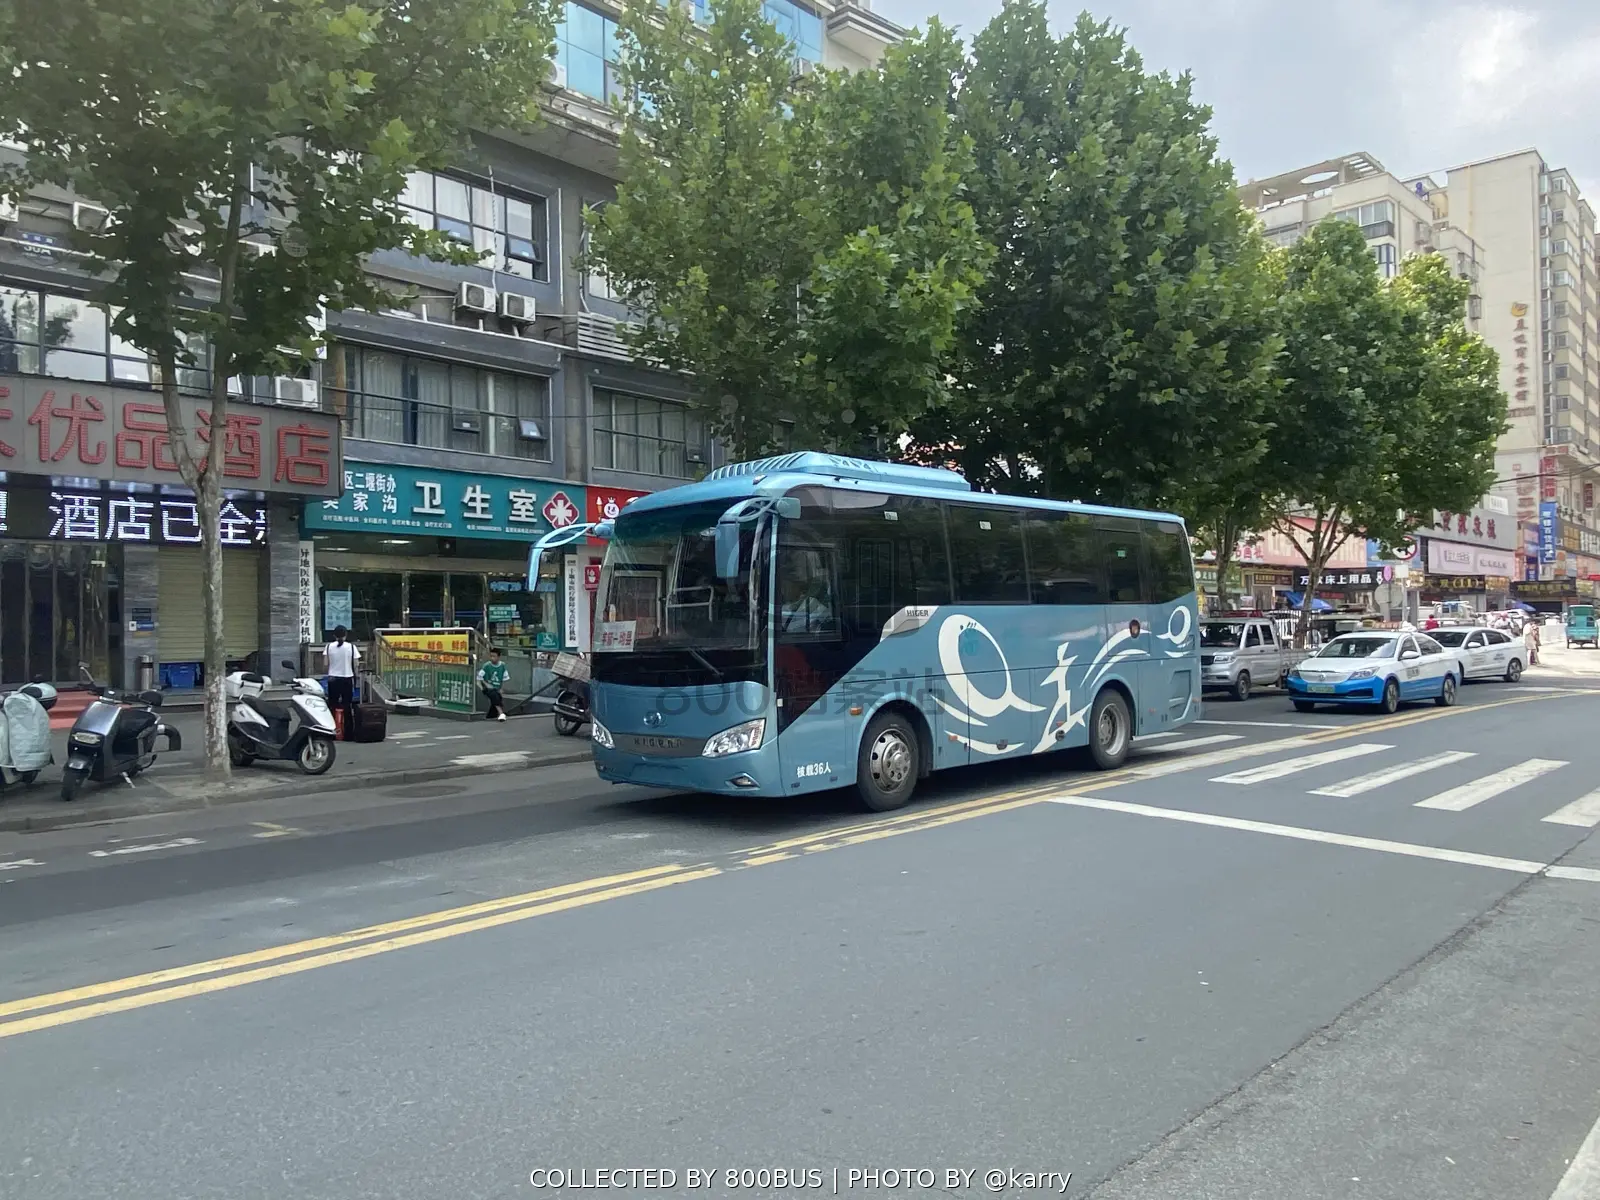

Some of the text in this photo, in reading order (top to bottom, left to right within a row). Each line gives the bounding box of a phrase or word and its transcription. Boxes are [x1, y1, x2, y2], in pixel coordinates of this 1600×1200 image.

[413, 480, 538, 523] 卫生室
[906, 609, 929, 617] HIGER
[797, 761, 832, 779] 核载36人
